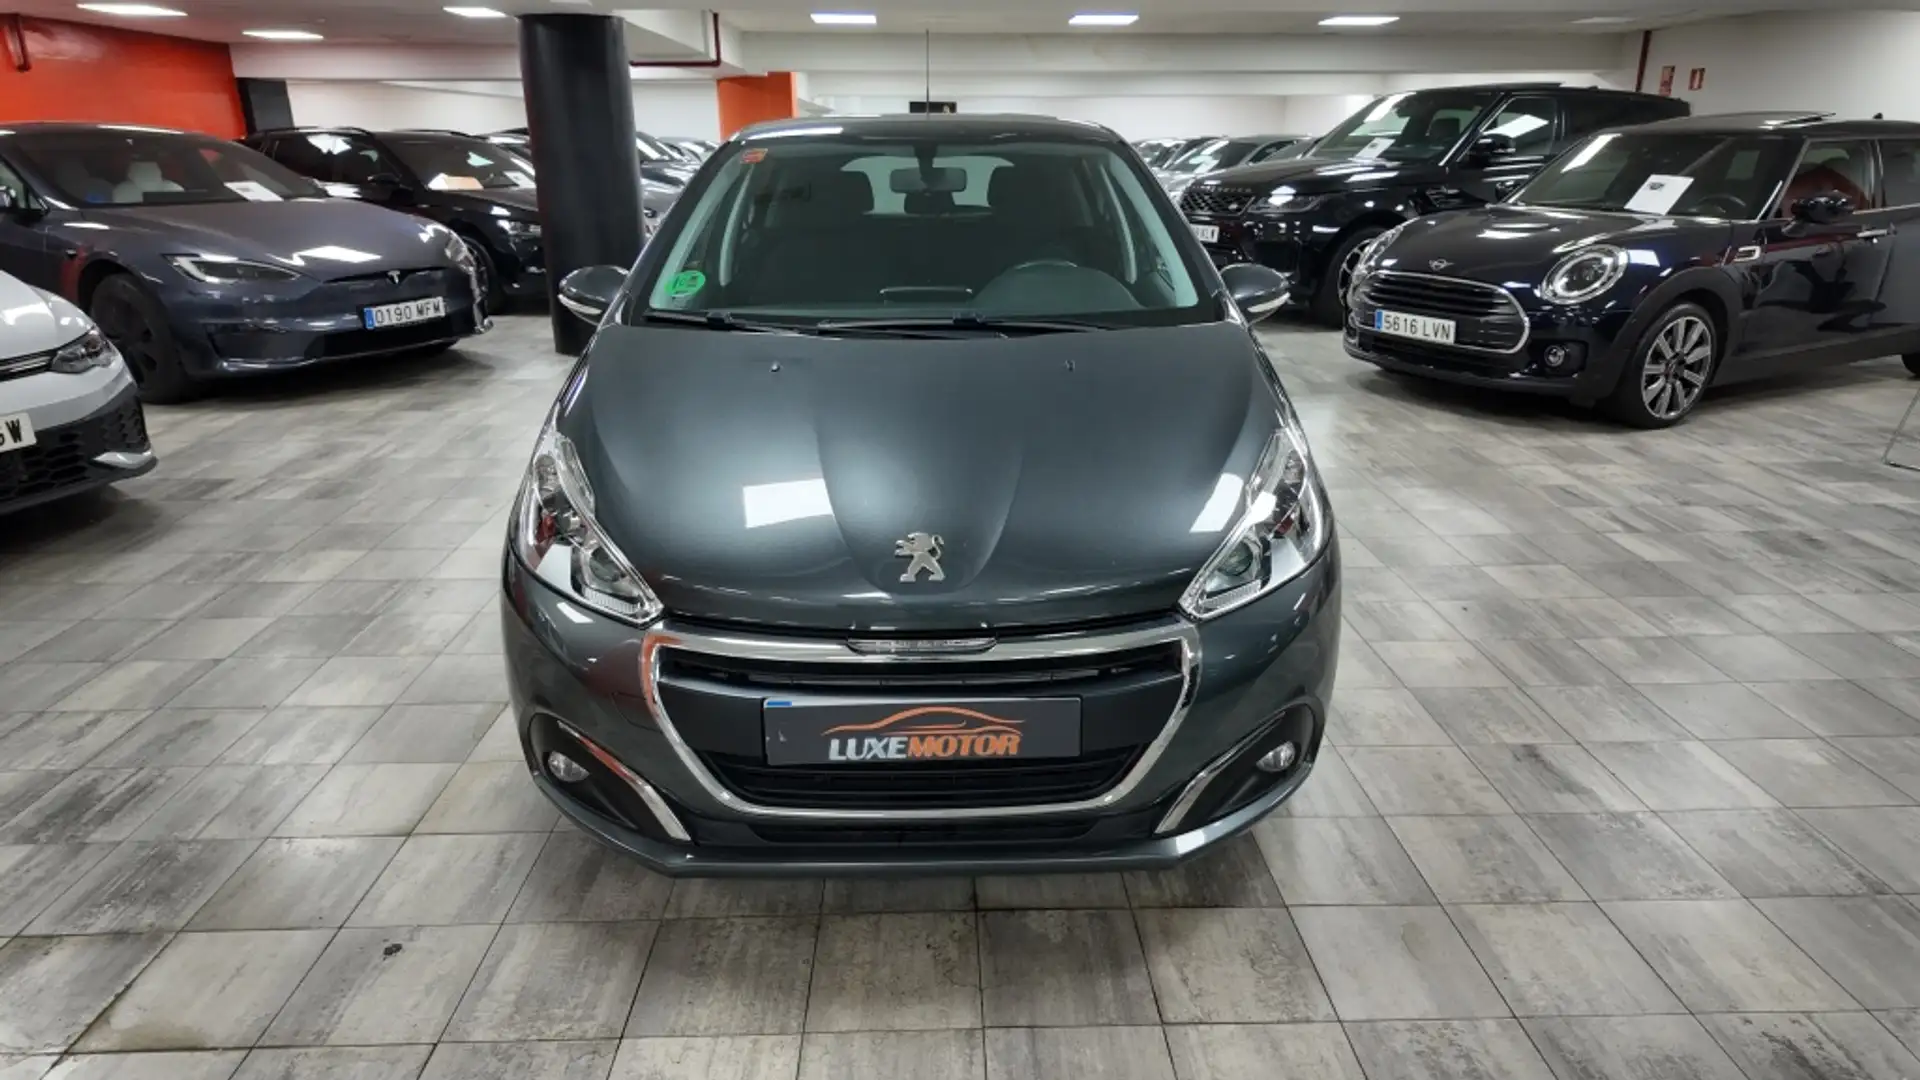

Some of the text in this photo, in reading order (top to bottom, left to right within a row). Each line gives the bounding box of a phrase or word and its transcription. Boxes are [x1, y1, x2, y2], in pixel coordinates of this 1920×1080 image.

[375, 305, 412, 324] 0190
[1384, 314, 1451, 340] 5616 LVN
[828, 734, 1021, 761] LUXEMOTOR
